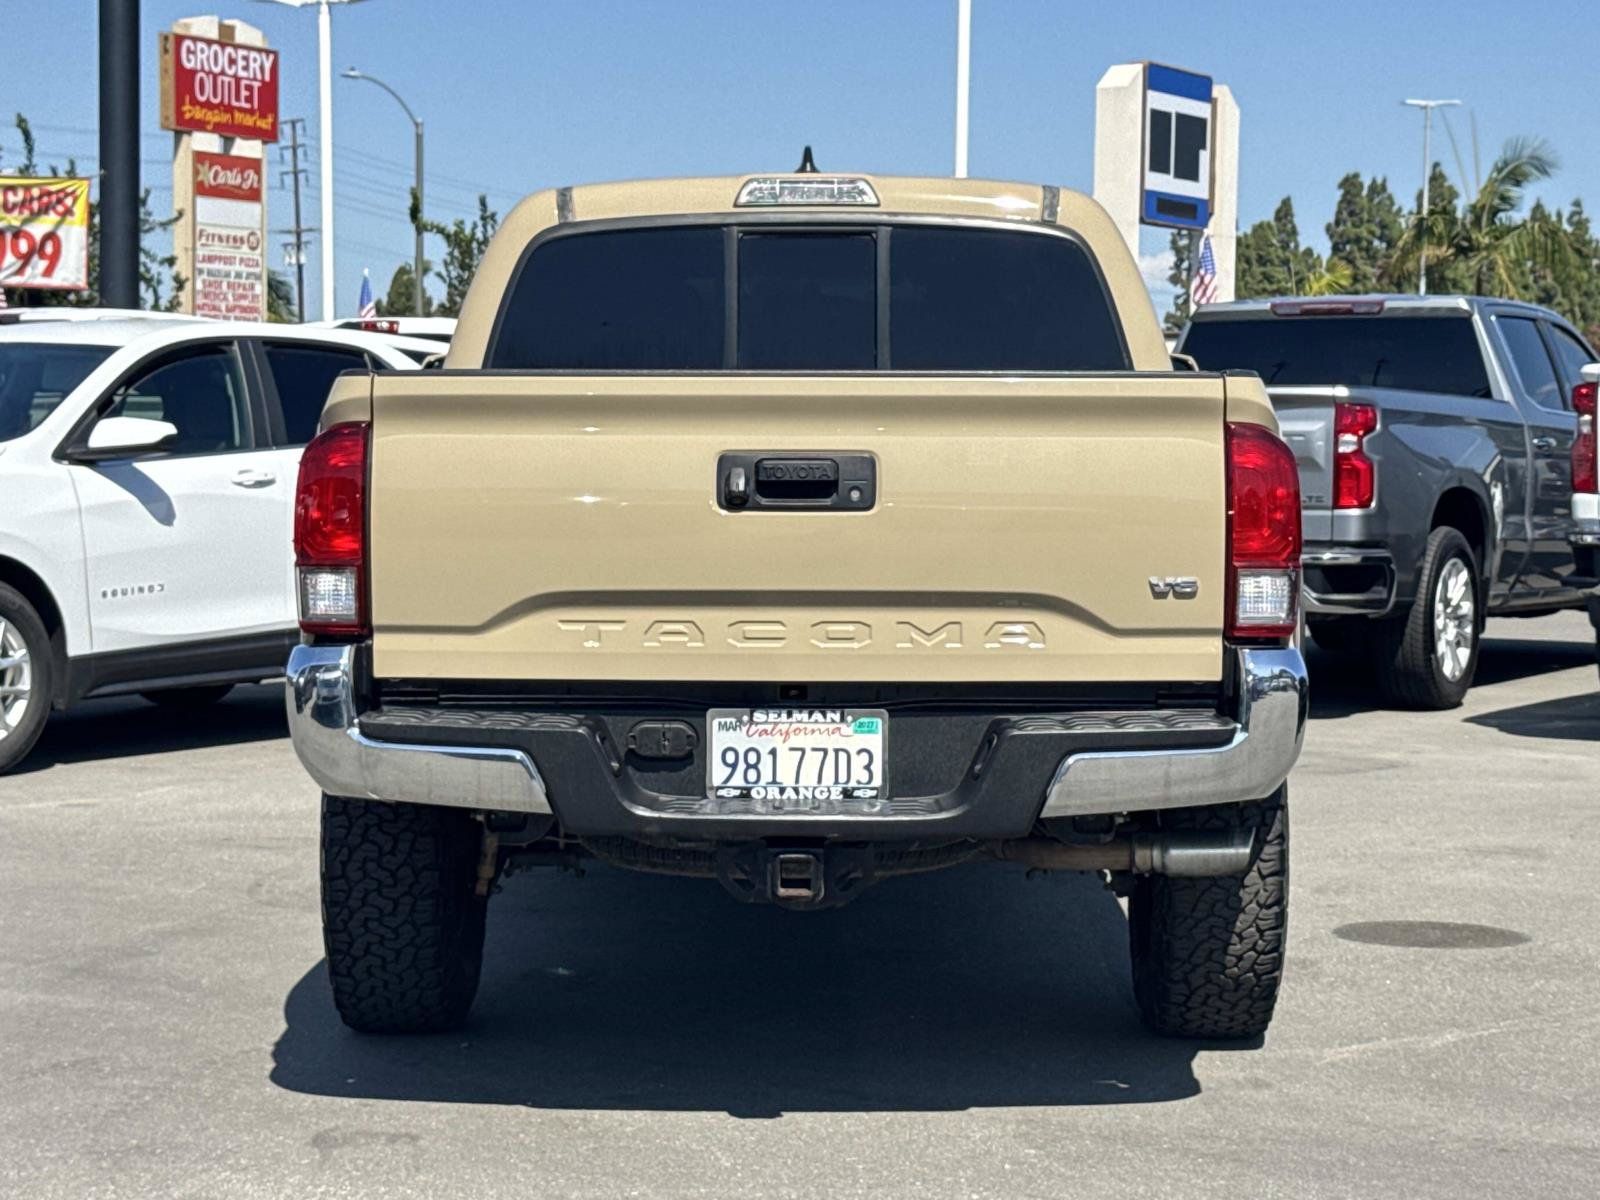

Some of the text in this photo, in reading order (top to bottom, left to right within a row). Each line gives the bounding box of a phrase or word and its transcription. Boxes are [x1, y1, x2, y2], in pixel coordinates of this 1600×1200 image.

[180, 39, 275, 82] GROCERY
[194, 71, 262, 110] OUTLET
[208, 164, 242, 187] Carl's
[0, 228, 62, 277] 99
[763, 465, 831, 479] TOYOTA
[1148, 576, 1199, 600] V6
[558, 620, 1046, 648] TACOMA
[752, 710, 842, 723] SELMAN
[718, 720, 742, 732] MAR
[745, 721, 854, 744] California
[720, 746, 875, 786] 98177D3
[750, 786, 844, 800] ORANGE
